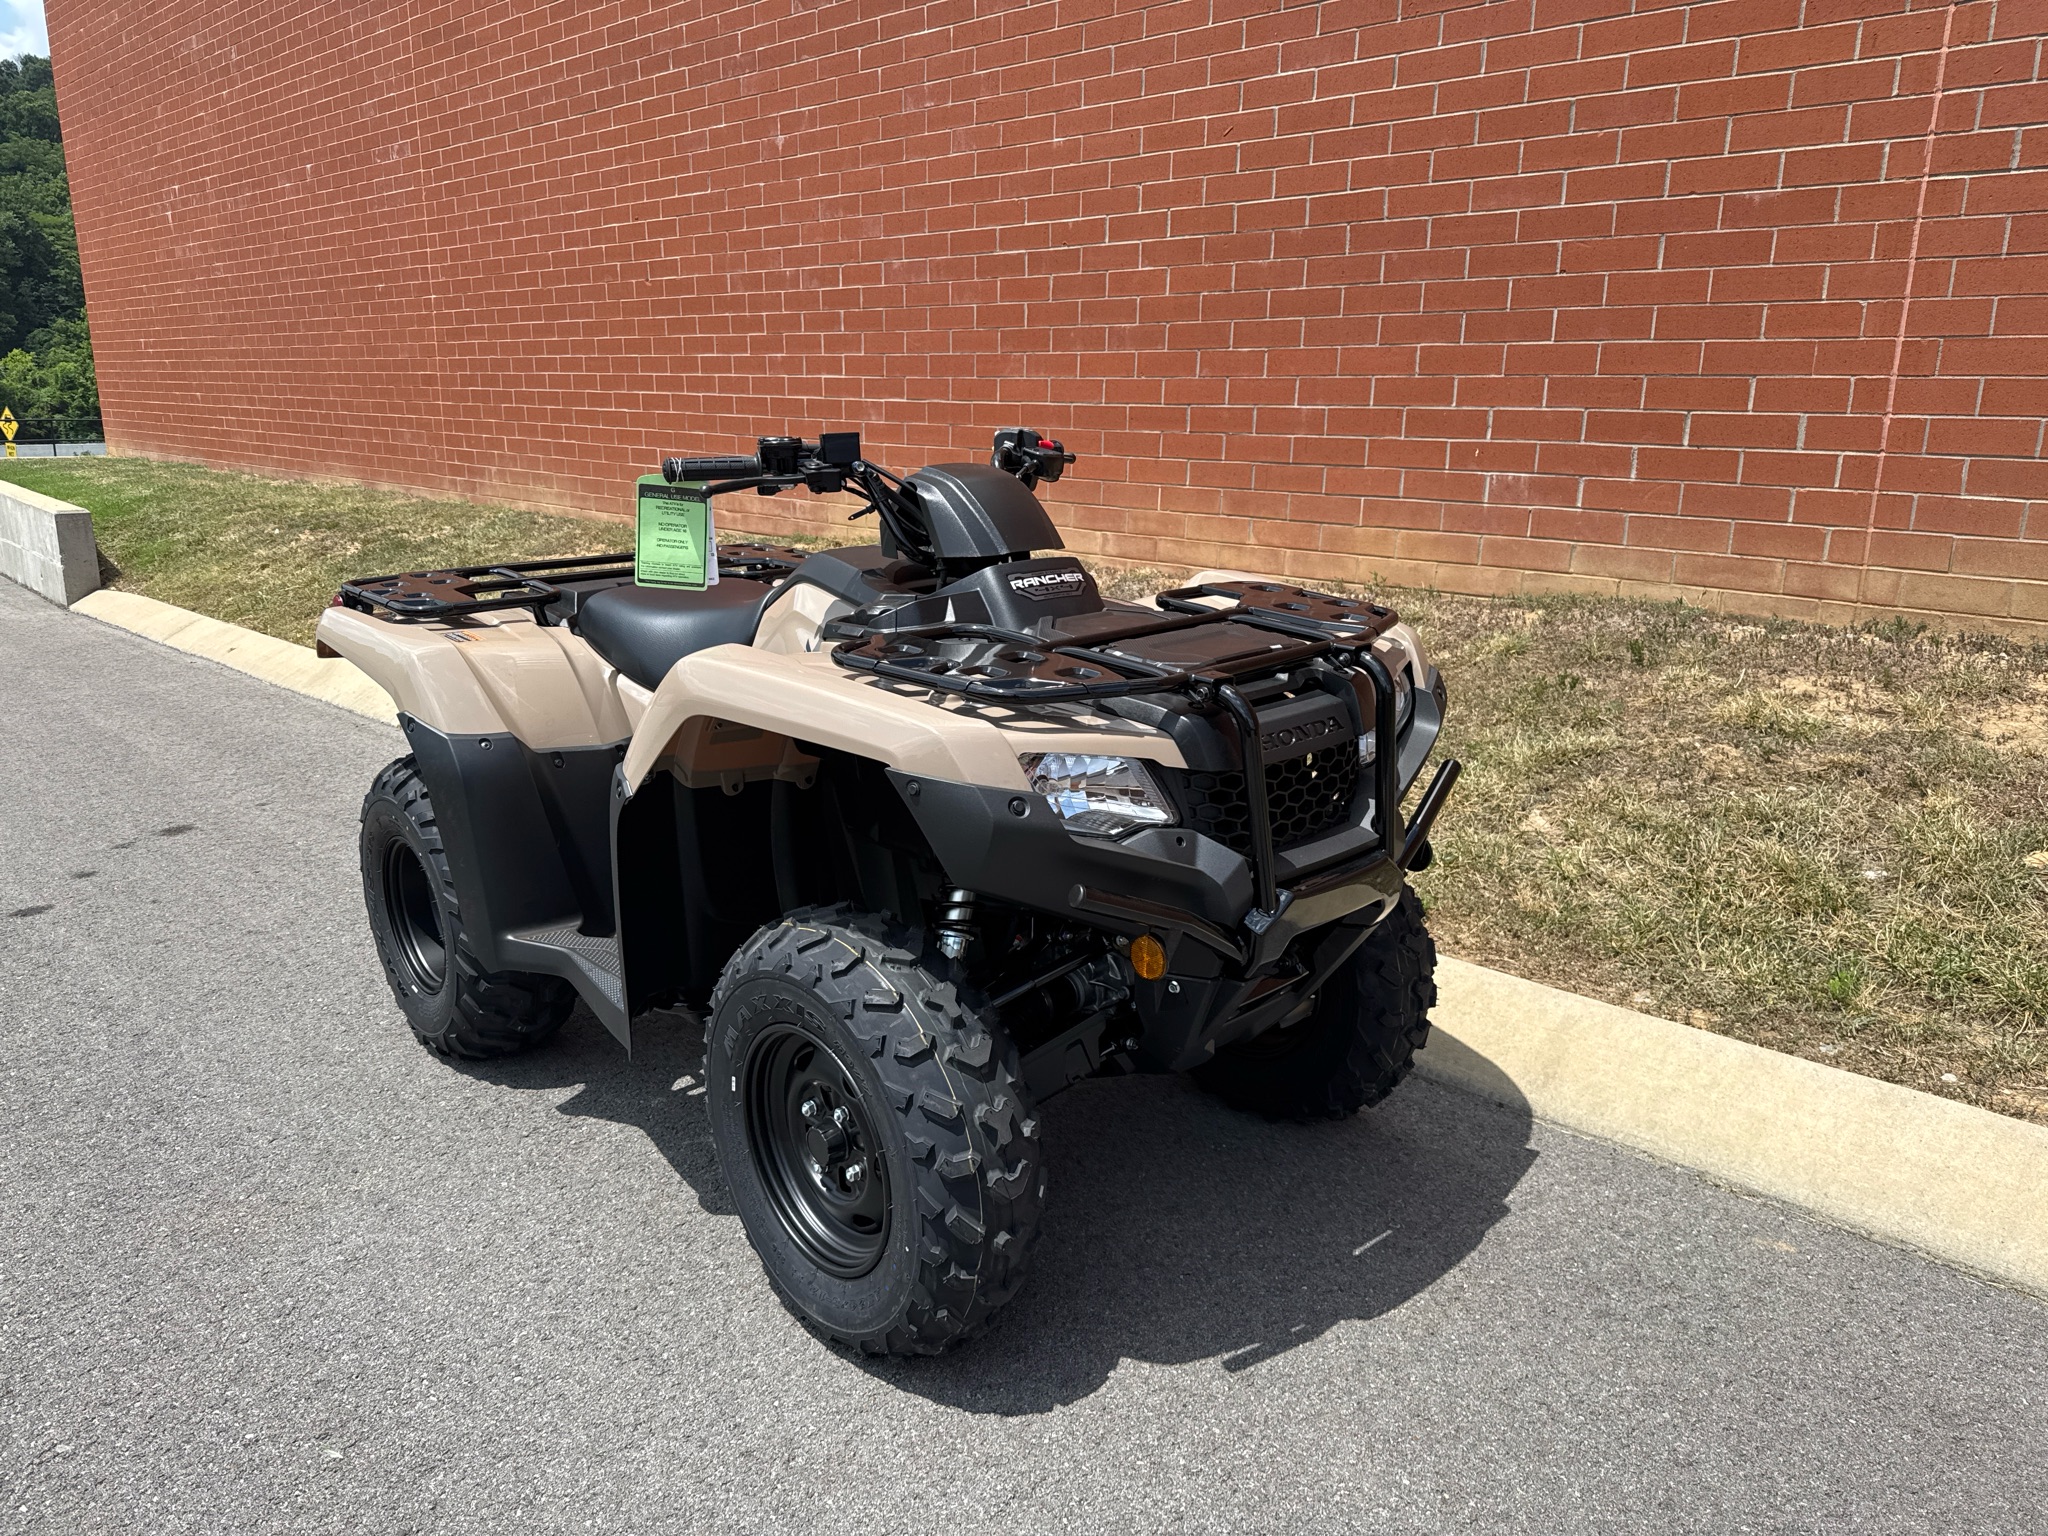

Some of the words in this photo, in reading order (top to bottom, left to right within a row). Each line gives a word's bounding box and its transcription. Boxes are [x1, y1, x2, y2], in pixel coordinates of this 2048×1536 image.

[644, 491, 669, 499] GENERAL
[1009, 572, 1085, 590] RANCHER
[1260, 716, 1345, 752] HONDA
[723, 993, 827, 1060] MAXXIS
